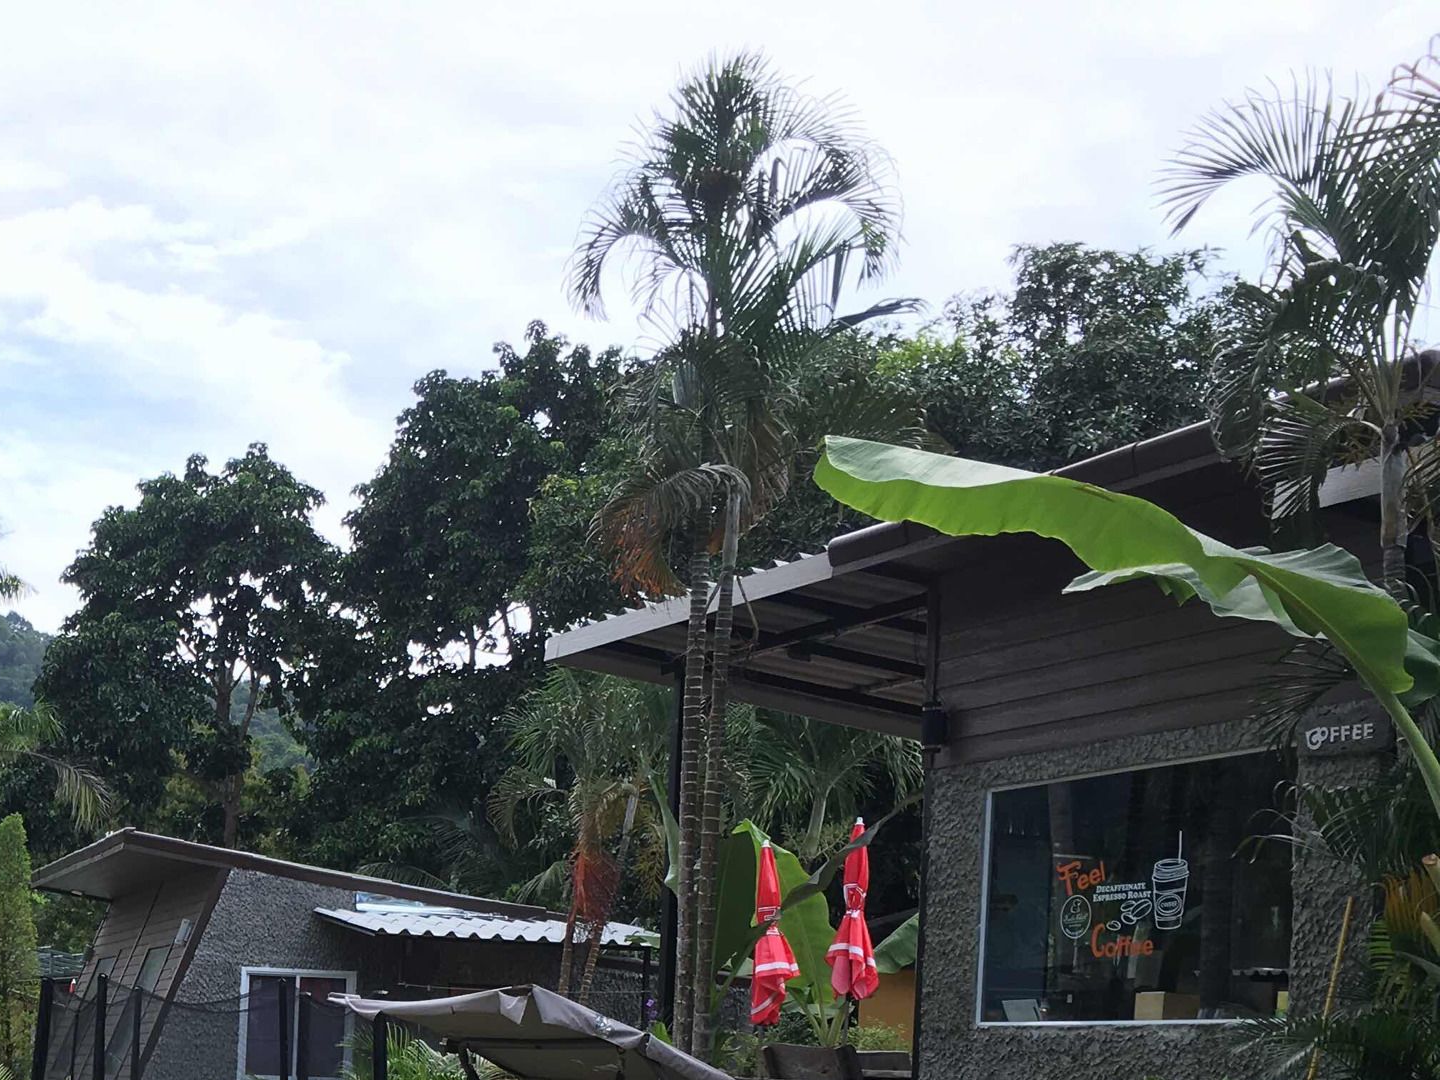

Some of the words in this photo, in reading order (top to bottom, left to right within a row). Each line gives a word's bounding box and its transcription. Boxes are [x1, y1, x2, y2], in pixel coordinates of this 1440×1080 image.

[1305, 723, 1374, 750] COFFEE
[1056, 861, 1106, 896] Feel
[1091, 923, 1154, 958] Coffee
